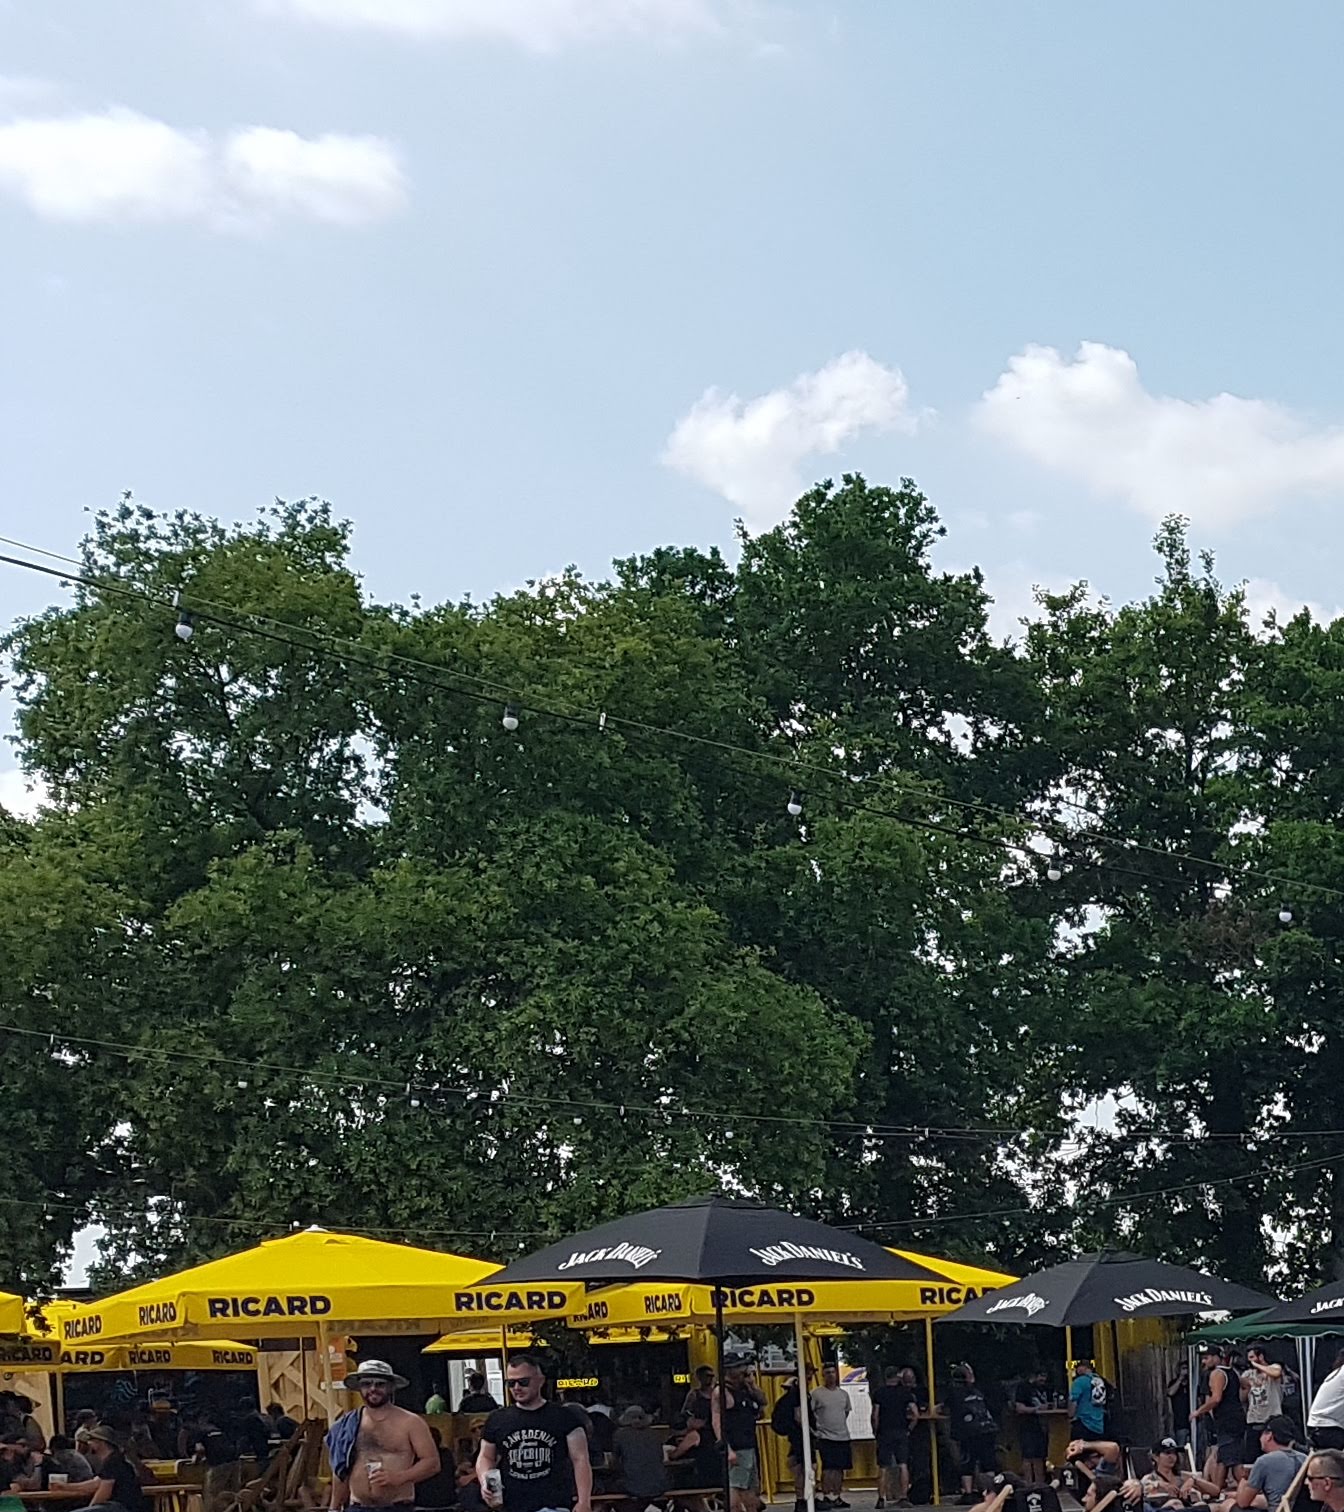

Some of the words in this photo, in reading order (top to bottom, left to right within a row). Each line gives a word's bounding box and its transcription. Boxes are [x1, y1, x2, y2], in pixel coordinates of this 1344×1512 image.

[778, 1241, 866, 1271] DANIEL'S
[208, 1295, 331, 1318] RICARD
[455, 1291, 567, 1312] RICARD
[644, 1293, 683, 1314] RICARD
[711, 1288, 815, 1308] RICARD
[920, 1287, 998, 1305] RICA
[1114, 1293, 1153, 1312] JACK
[1144, 1288, 1214, 1307] DANIEL'S
[139, 1301, 177, 1326] RICARD
[64, 1314, 102, 1340] RICARD
[61, 1350, 104, 1365] ARD
[129, 1350, 171, 1364] RICARD
[213, 1350, 253, 1364] RICARD
